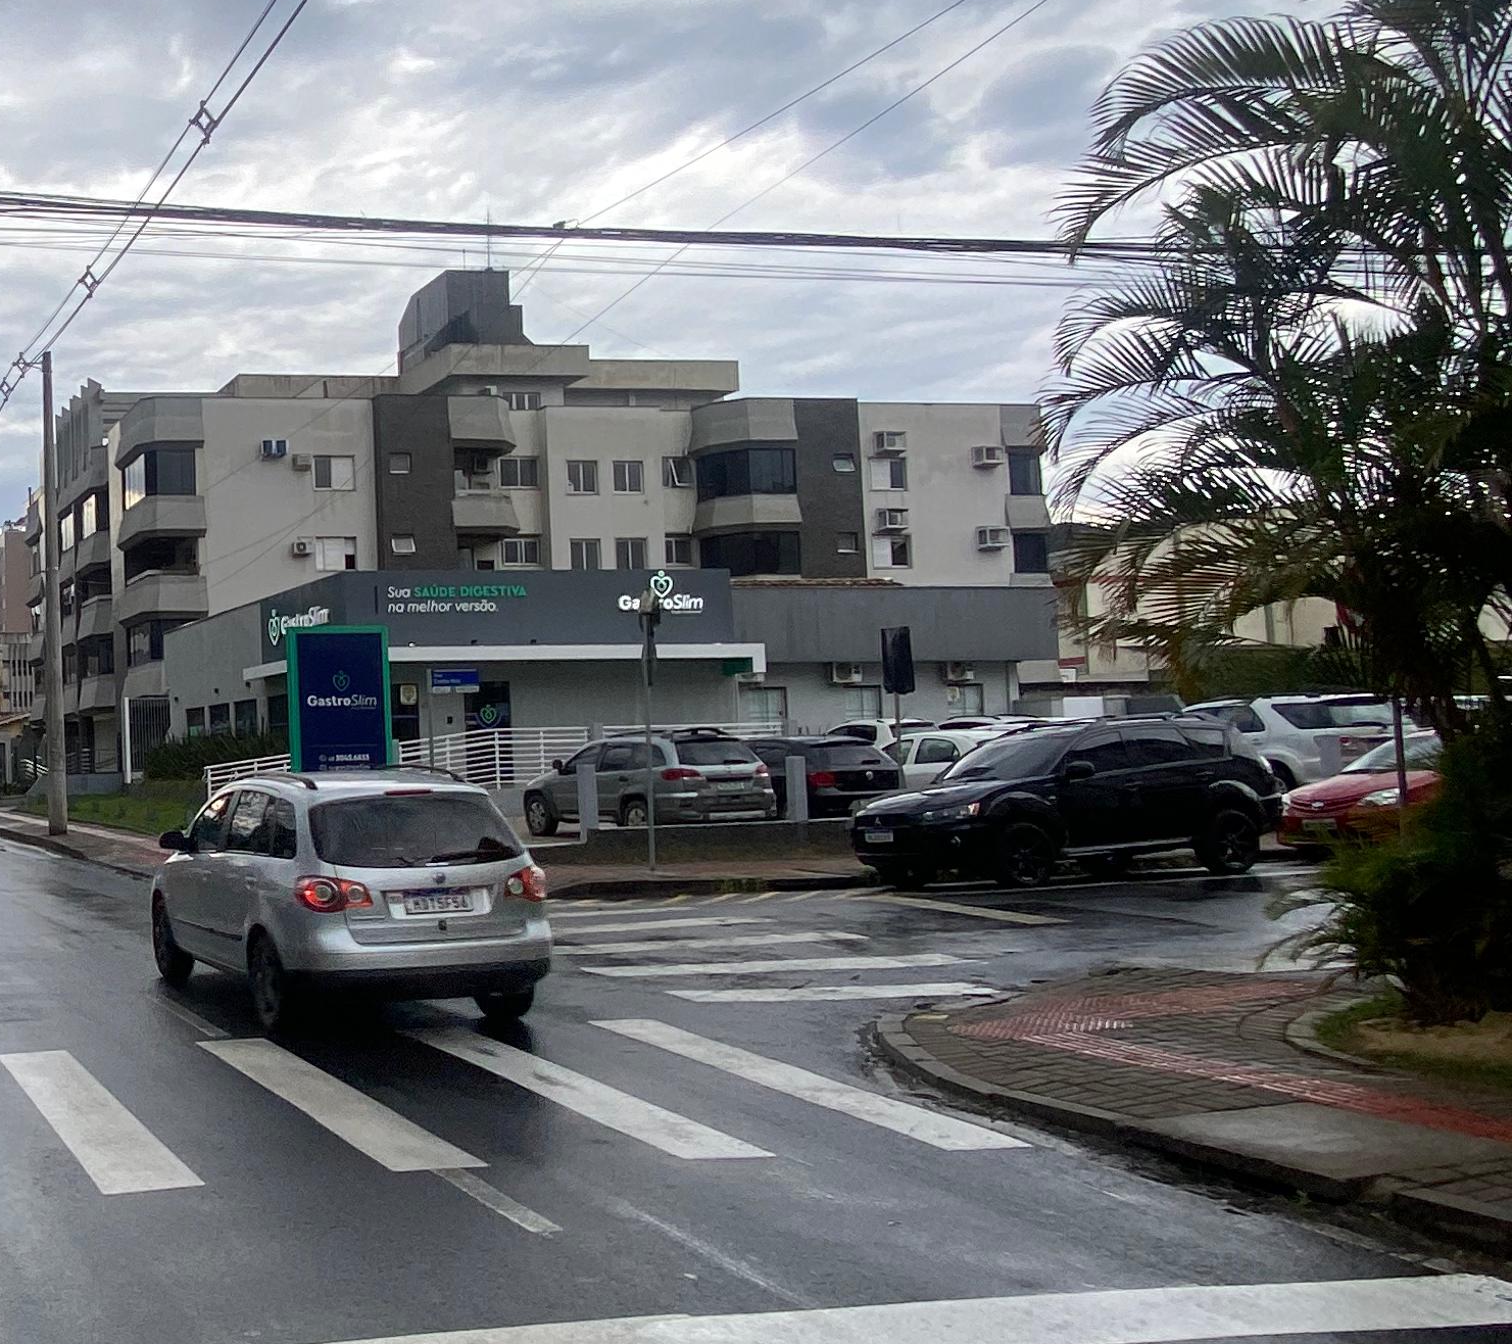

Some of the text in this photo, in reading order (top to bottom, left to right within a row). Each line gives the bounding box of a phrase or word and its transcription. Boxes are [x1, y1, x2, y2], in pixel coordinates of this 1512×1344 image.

[387, 584, 527, 598] Sua SAÚDE DIGESTIVA
[387, 602, 405, 613] na
[407, 600, 452, 613] melhor
[307, 694, 378, 707] GastroSlim
